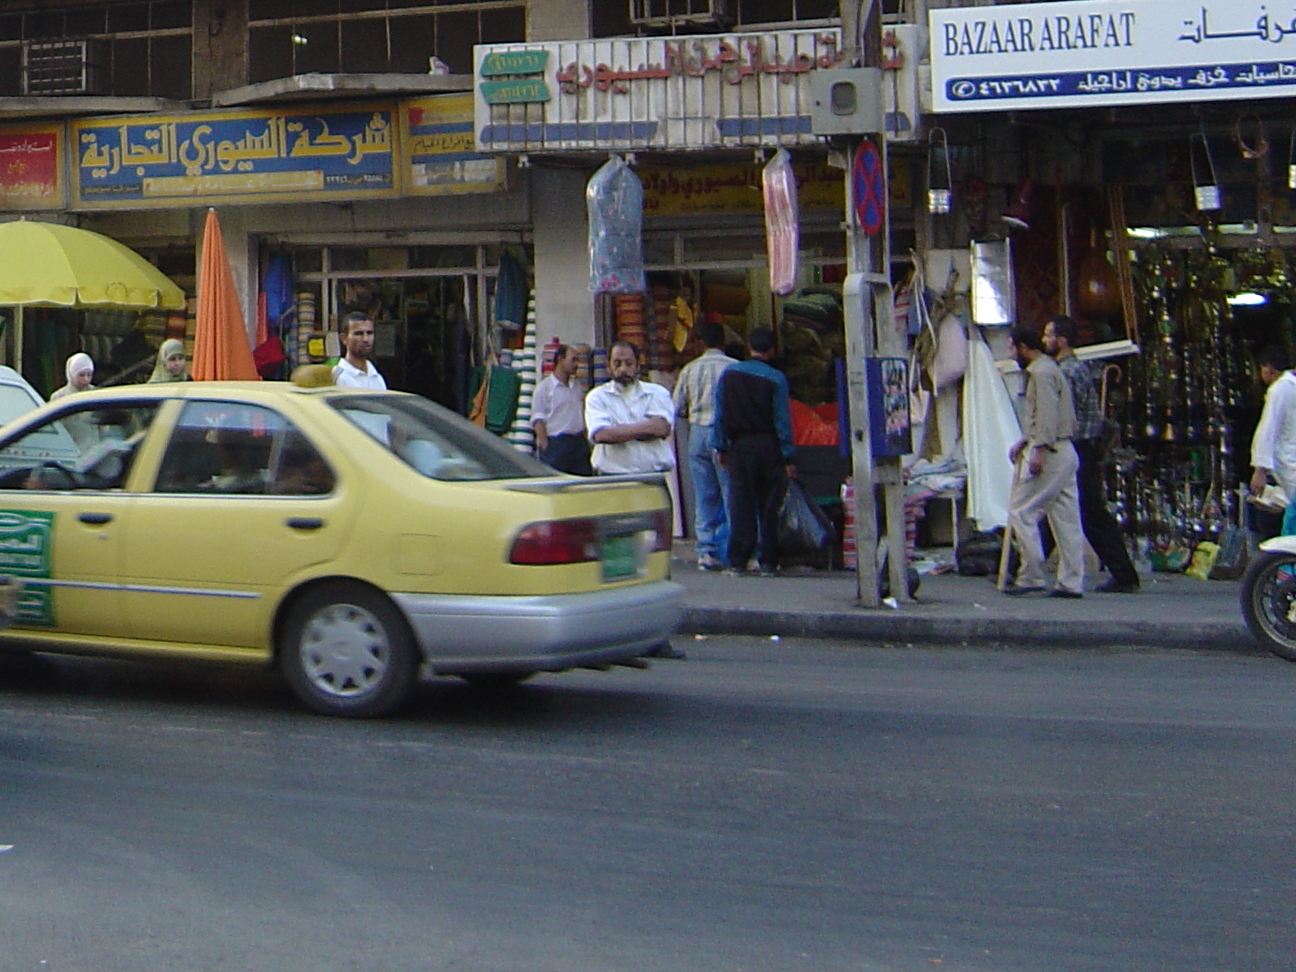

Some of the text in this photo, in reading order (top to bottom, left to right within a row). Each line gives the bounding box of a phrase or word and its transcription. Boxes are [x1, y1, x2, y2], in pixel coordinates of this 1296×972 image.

[943, 11, 1136, 57] BAZAAR ARAFAT
[1235, 62, 1296, 84] حاسيات
[80, 112, 392, 179] شركة السيوري التجارية
